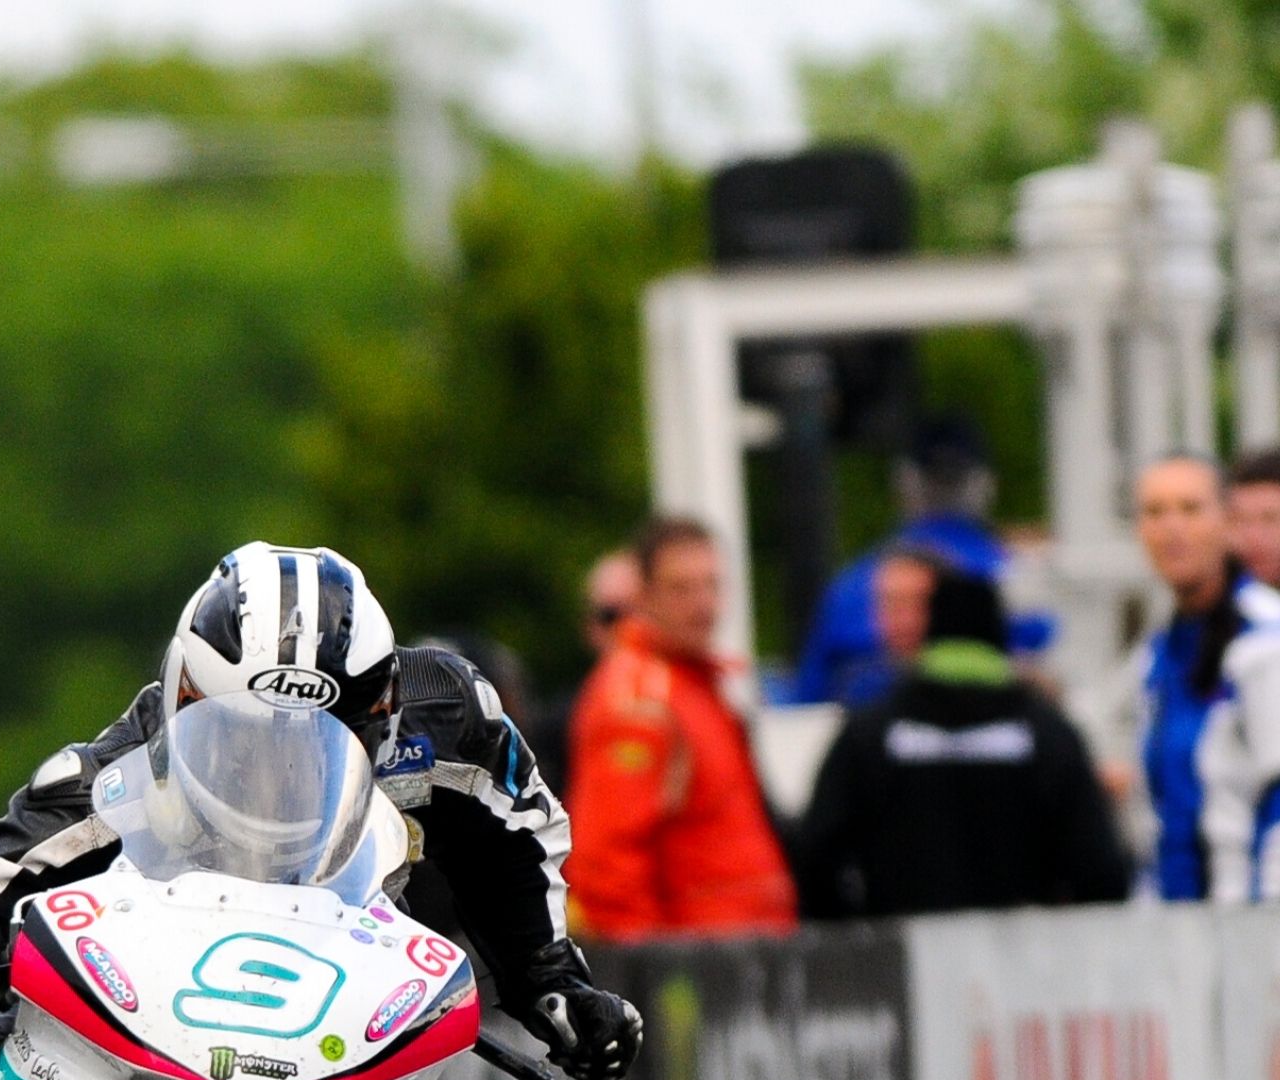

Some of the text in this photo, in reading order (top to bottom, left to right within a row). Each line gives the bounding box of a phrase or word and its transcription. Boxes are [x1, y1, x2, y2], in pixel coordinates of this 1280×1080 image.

[256, 672, 329, 700] Arai
[406, 935, 457, 977] GO
[172, 931, 347, 1040] 9
[234, 1055, 296, 1076] MONSTER
